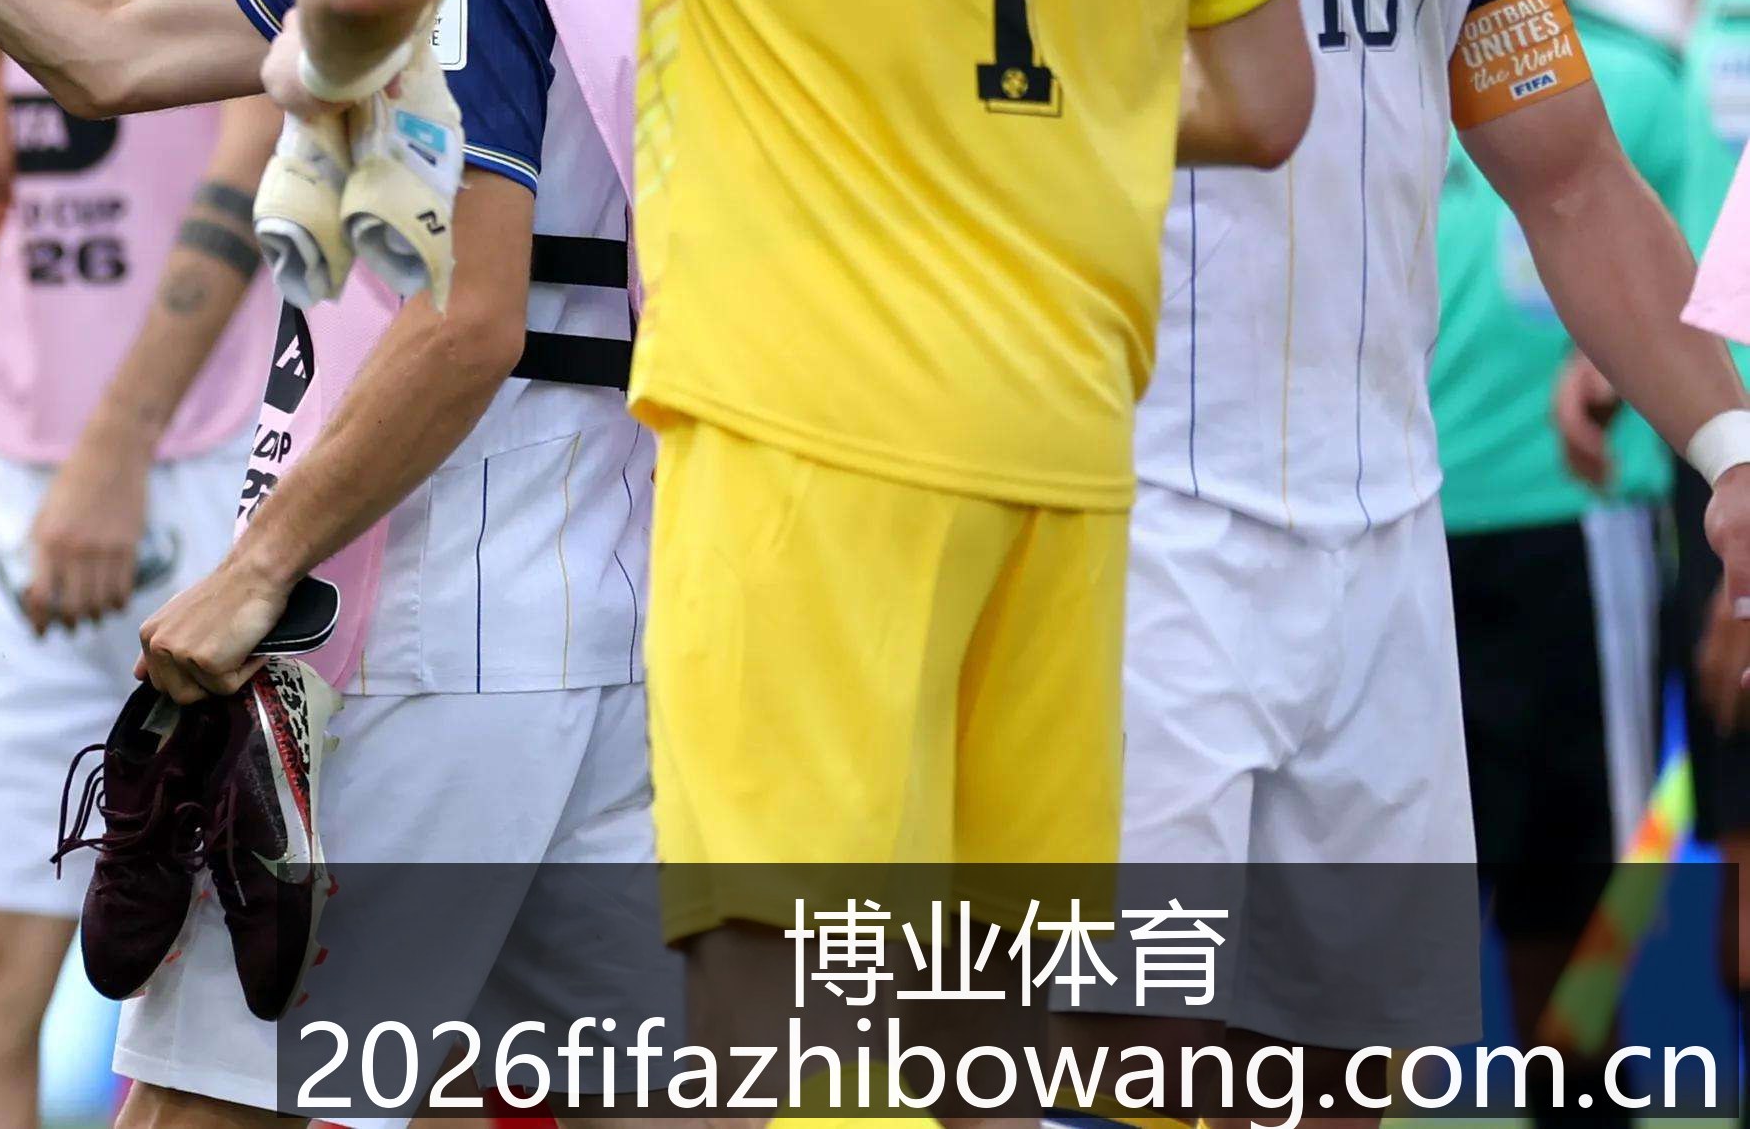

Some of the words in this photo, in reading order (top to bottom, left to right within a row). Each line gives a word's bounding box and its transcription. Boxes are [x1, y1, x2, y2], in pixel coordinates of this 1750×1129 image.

[1461, 11, 1560, 68] UNITES
[1511, 33, 1573, 77] World
[1513, 73, 1554, 97] FIFA
[23, 234, 130, 288] 26
